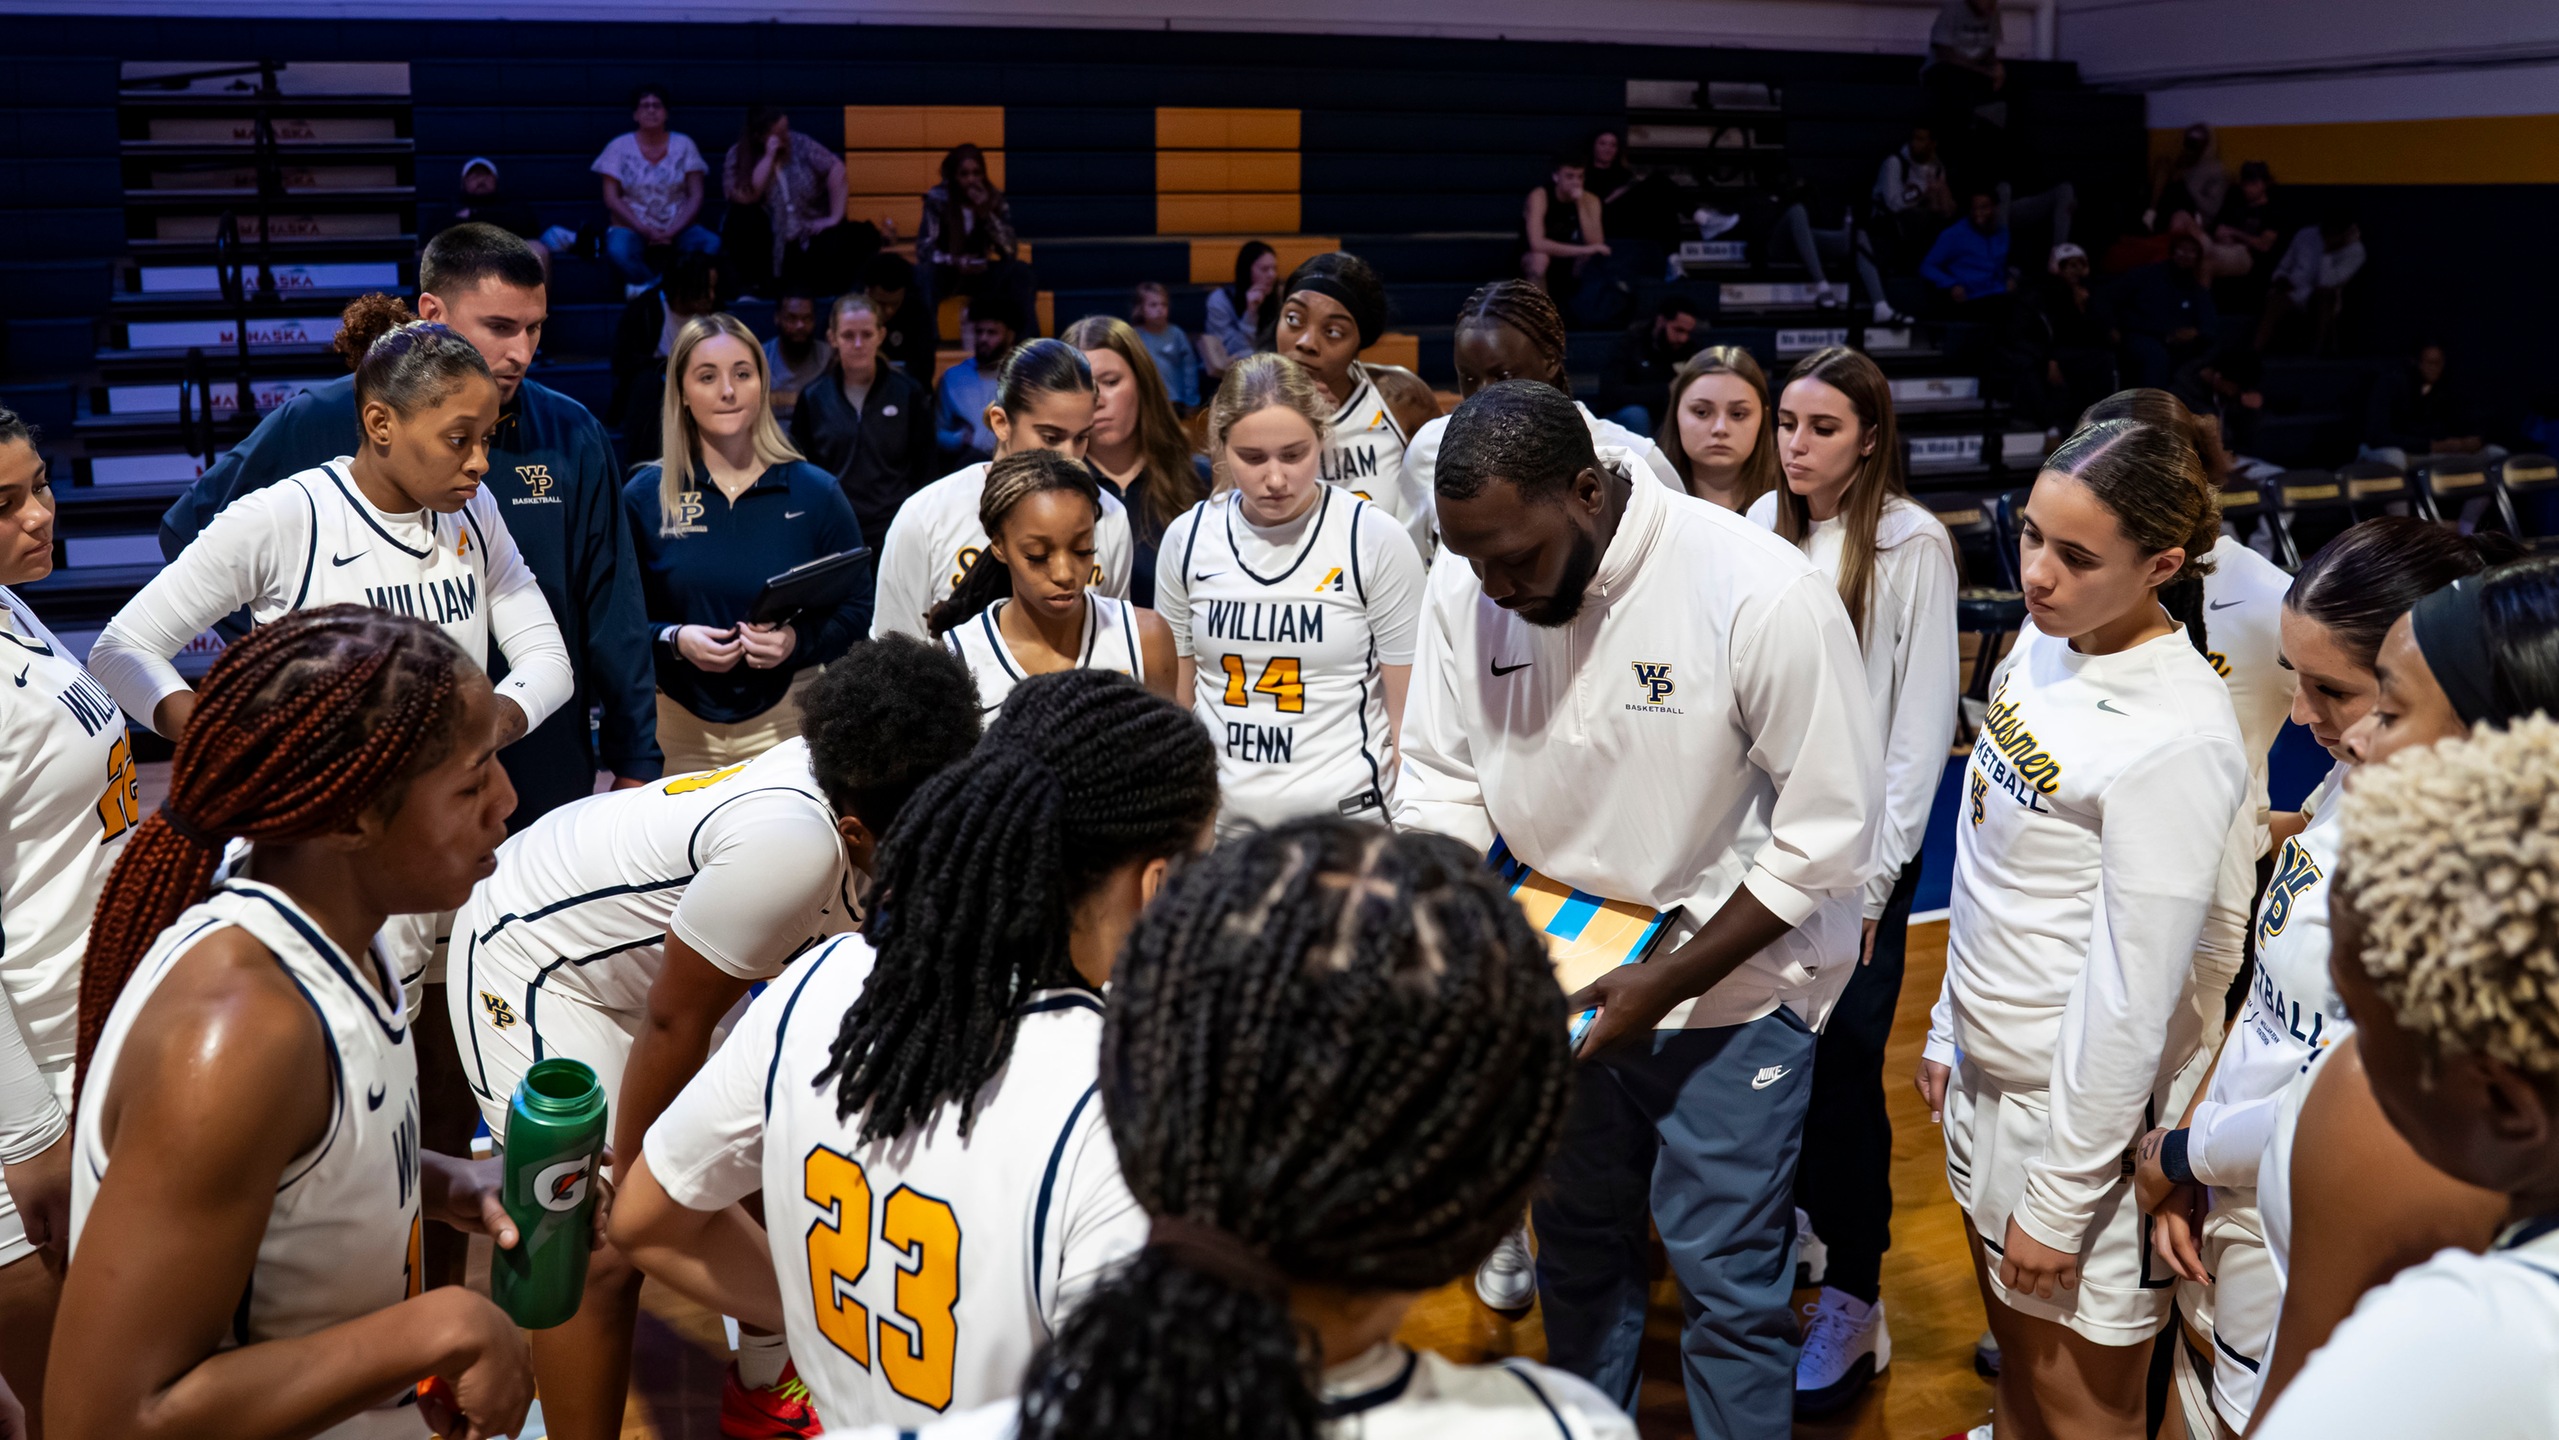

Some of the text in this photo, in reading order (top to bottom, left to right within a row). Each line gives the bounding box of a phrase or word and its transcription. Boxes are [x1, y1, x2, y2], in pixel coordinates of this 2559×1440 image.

[220, 329, 308, 343] MHASKA
[1320, 444, 1377, 481] LIAM
[511, 496, 563, 505] BASKETBALL
[1208, 599, 1323, 643] WILLIAM
[1220, 653, 1305, 714] 14
[1631, 660, 1676, 706] WP
[1625, 703, 1684, 715] BASKETBALL
[1227, 721, 1293, 763] PENN
[1983, 671, 2063, 796] tatesmen
[1974, 733, 2048, 814] SKETBALL
[2254, 951, 2322, 1049] ETBALL
[1756, 1064, 1783, 1081] NIKE
[533, 1153, 592, 1212] G
[803, 1142, 962, 1415] 23
